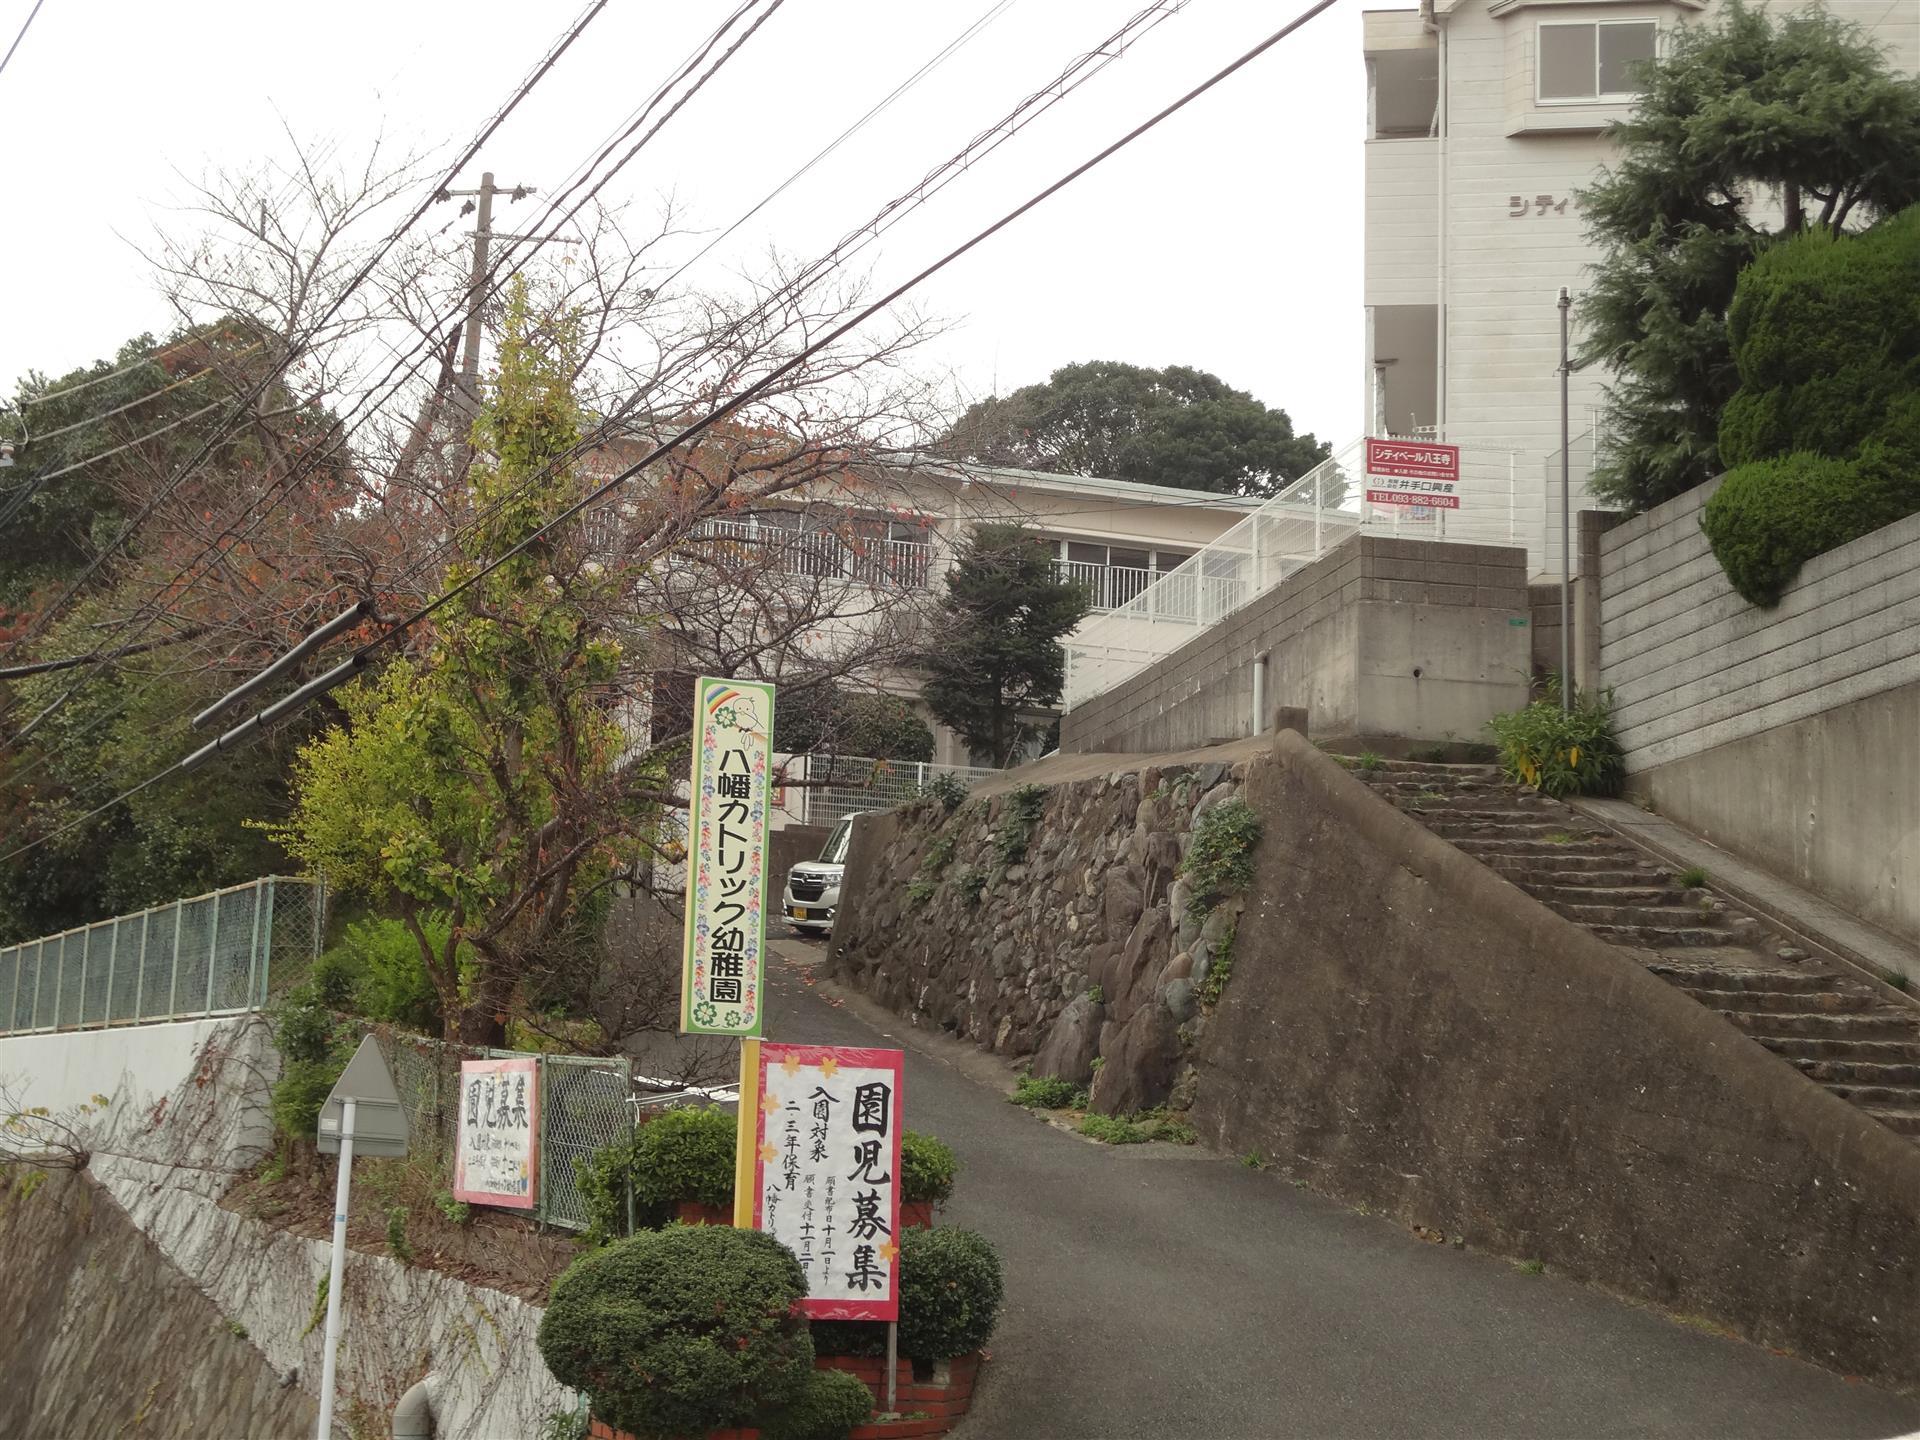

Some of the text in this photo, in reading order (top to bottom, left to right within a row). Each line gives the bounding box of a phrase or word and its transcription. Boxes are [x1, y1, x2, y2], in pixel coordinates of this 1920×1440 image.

[1509, 194, 1583, 217] シティ
[709, 749, 751, 1004] 八幡カトリック幼稚園
[807, 1086, 840, 1163] 入園対象
[845, 1082, 892, 1291] 園児募集
